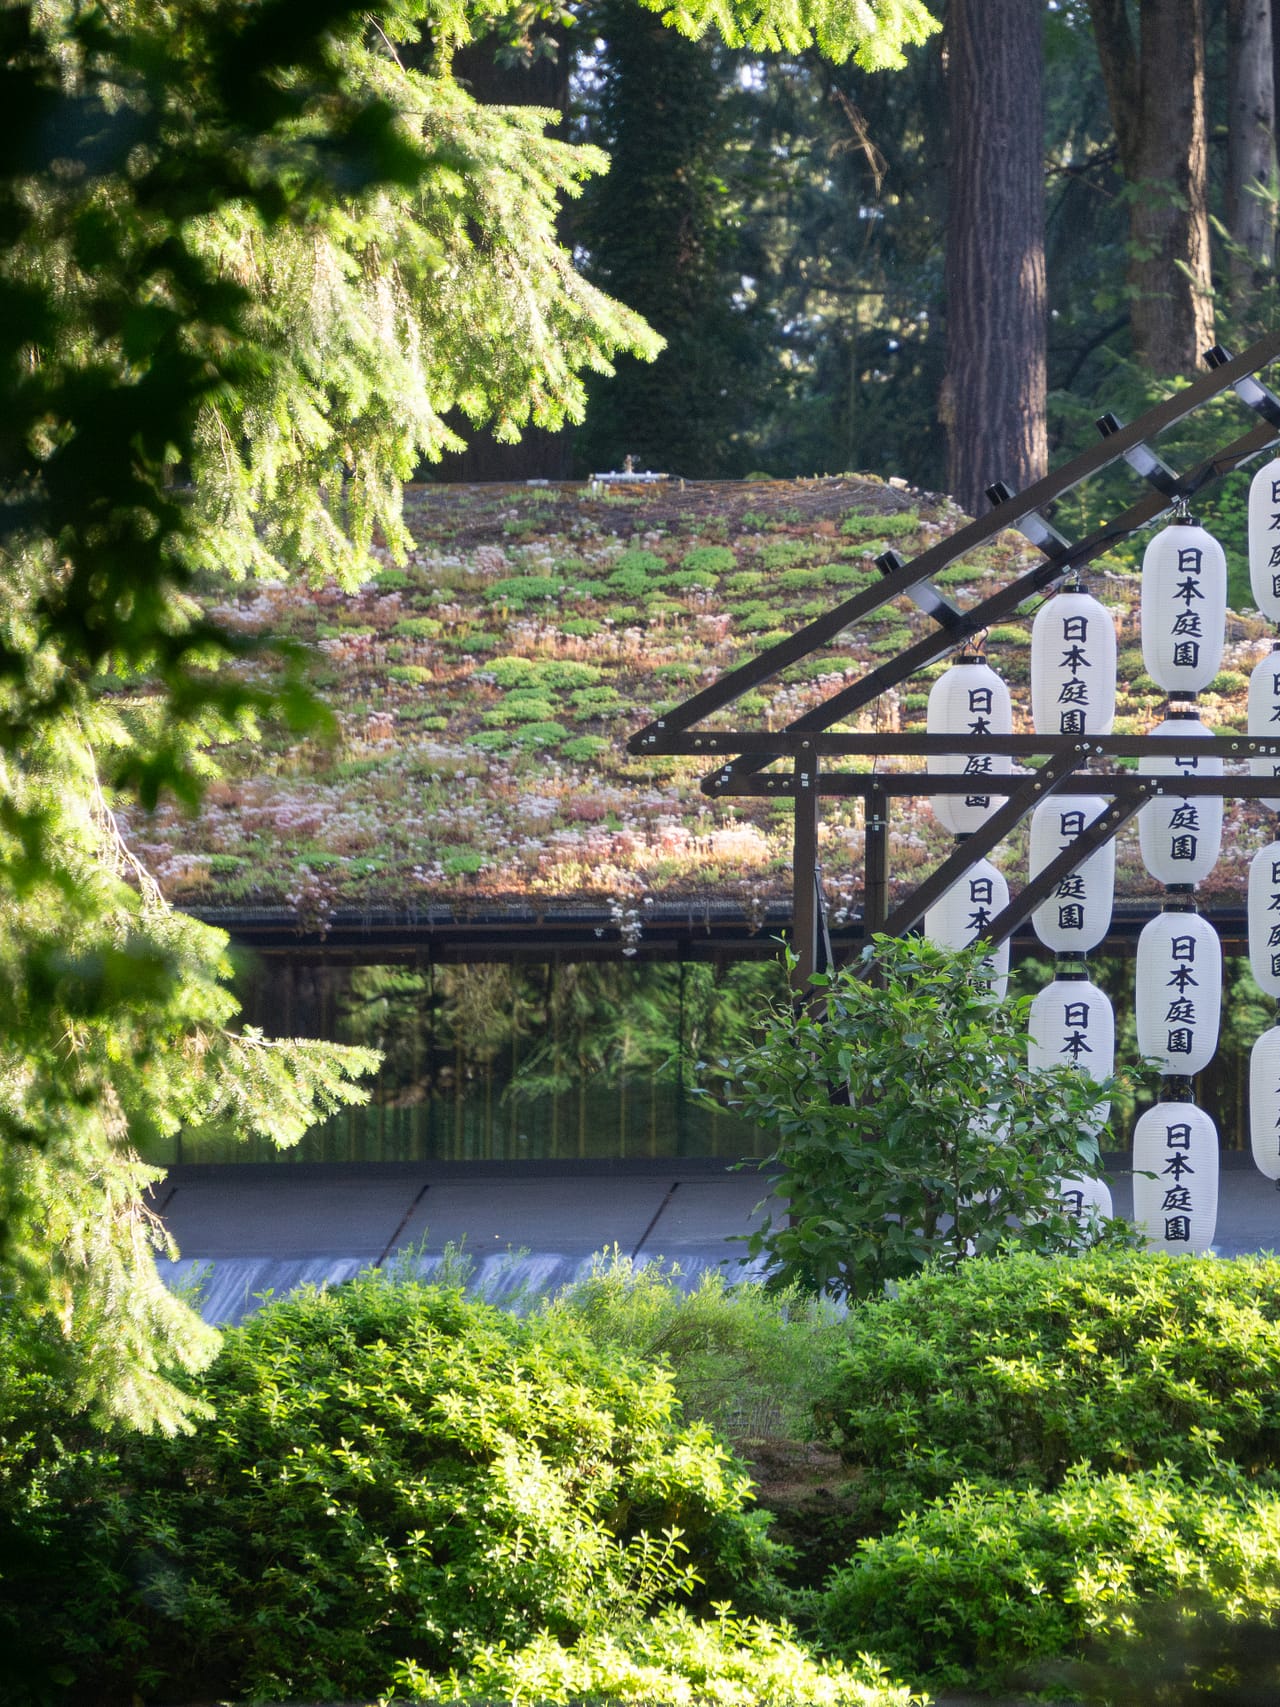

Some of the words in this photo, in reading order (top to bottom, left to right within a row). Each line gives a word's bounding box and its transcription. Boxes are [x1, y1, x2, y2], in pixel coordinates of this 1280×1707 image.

[1171, 548, 1205, 668] 日本庭園
[1058, 616, 1091, 735] 日本庭園
[1055, 811, 1087, 930] 日庭園
[1165, 935, 1199, 1055] 日本庭園
[1161, 1123, 1195, 1242] 日本庭園
